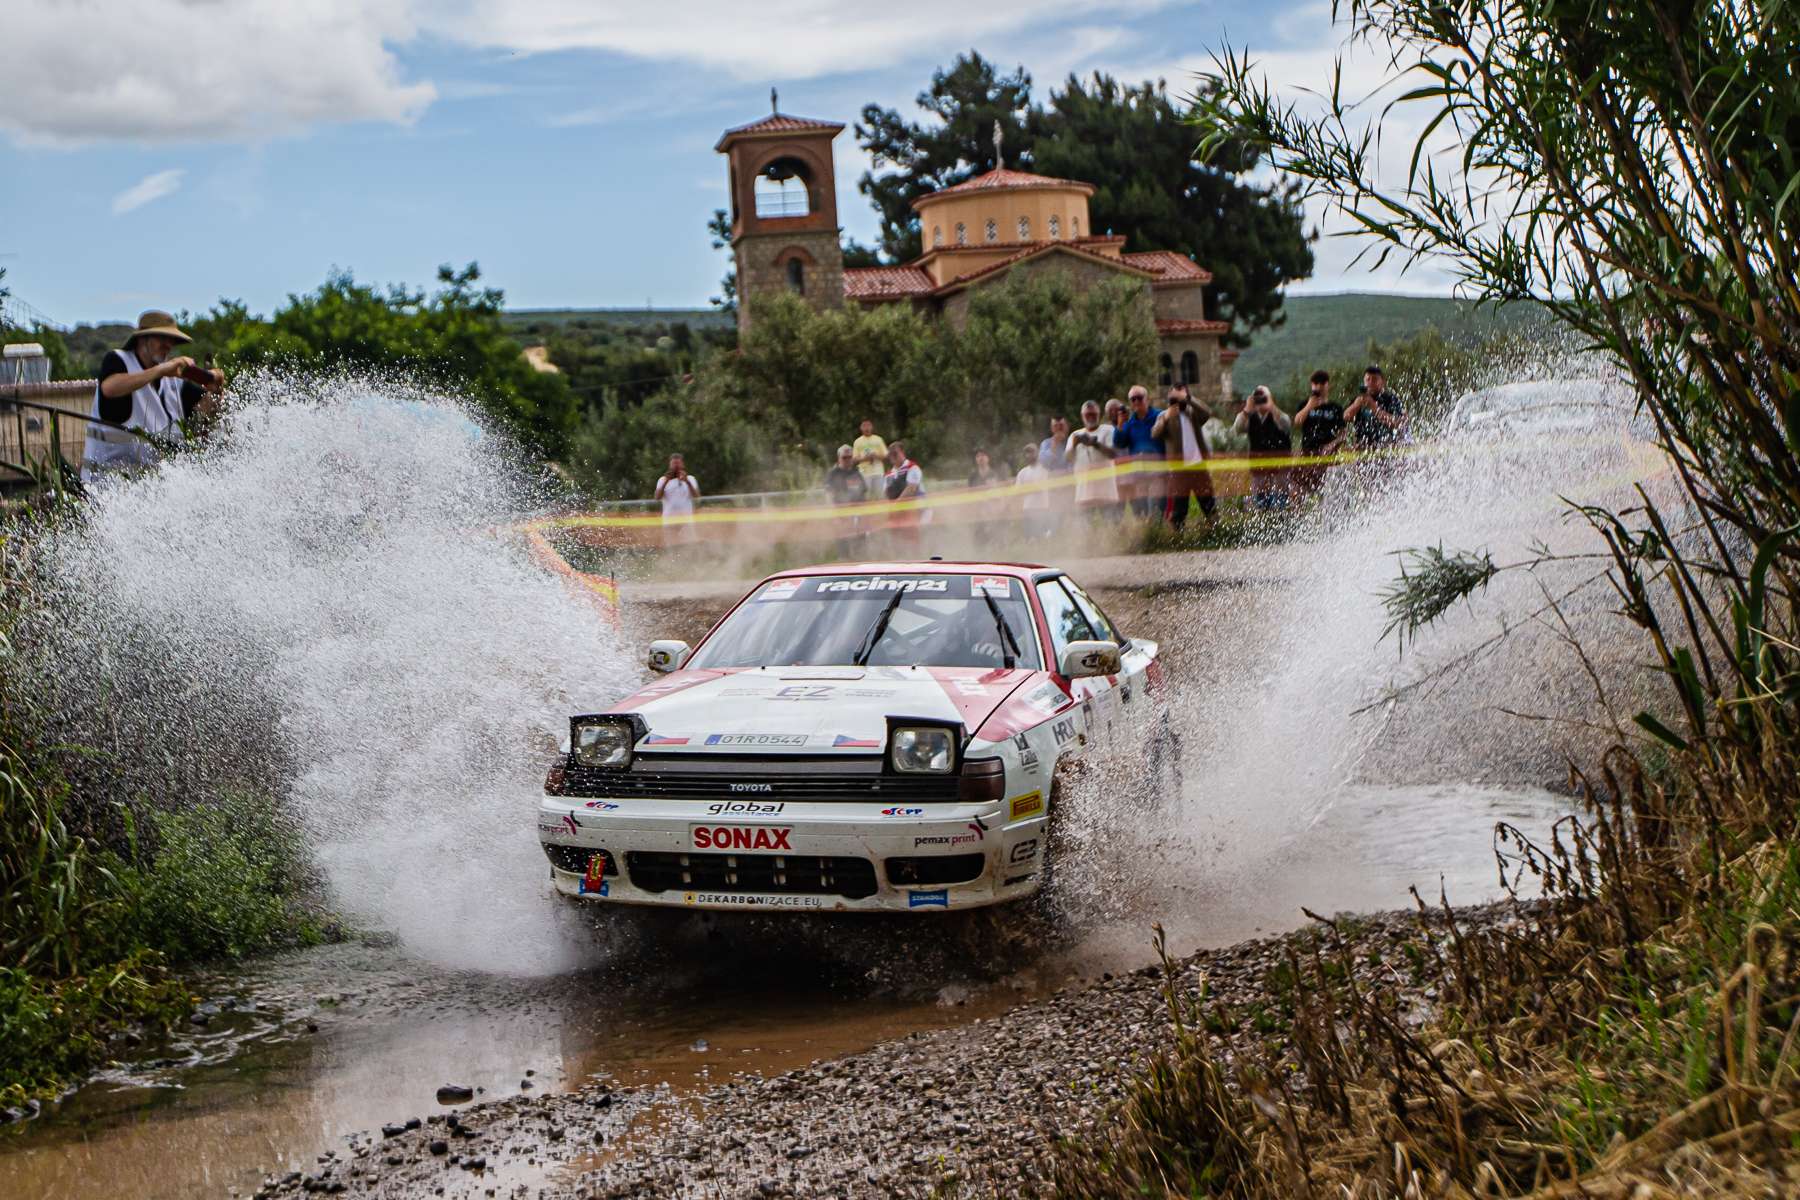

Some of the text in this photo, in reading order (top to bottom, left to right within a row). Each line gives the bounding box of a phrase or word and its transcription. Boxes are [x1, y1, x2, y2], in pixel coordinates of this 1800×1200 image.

[817, 577, 948, 594] racing21
[730, 783, 772, 792] TOYOTA
[707, 802, 785, 815] global
[694, 827, 792, 849] SONAX
[915, 834, 976, 847] pemax print
[698, 894, 820, 906] DEKARBONIZACE.EU
